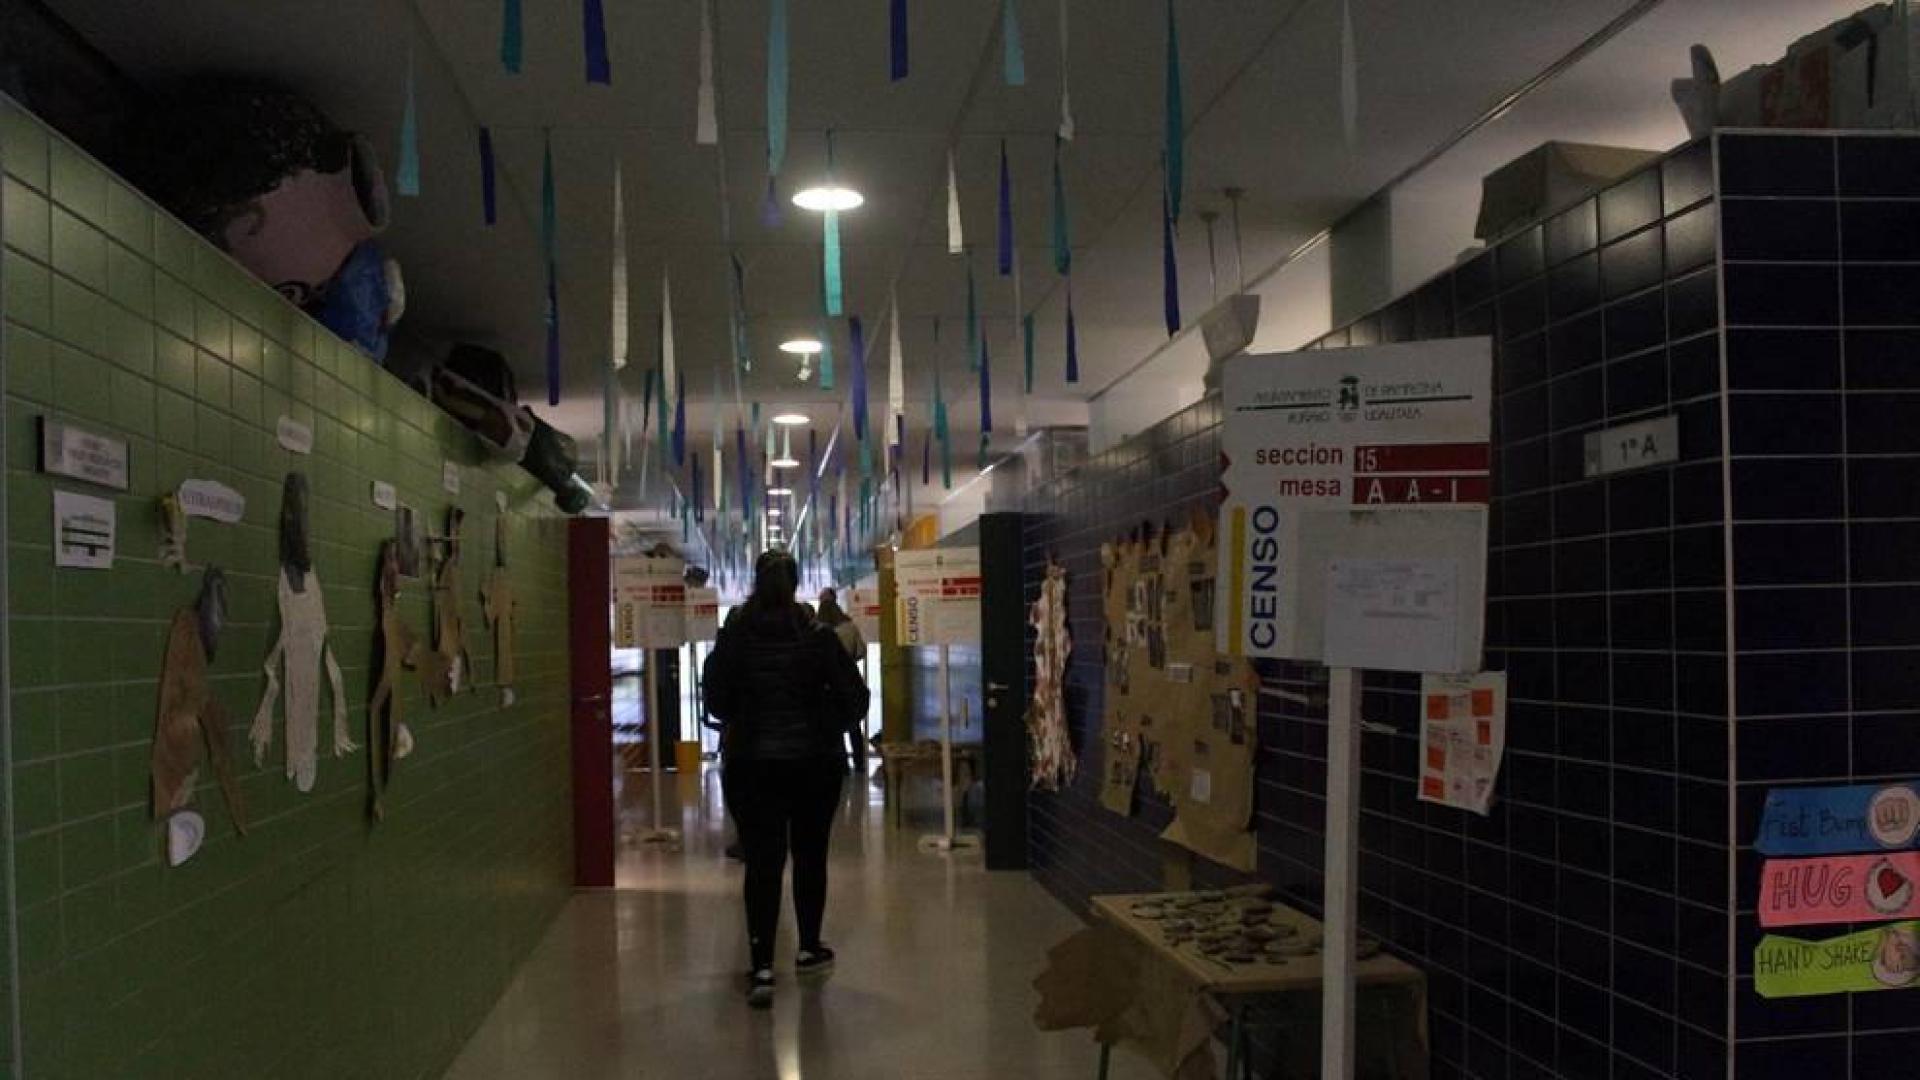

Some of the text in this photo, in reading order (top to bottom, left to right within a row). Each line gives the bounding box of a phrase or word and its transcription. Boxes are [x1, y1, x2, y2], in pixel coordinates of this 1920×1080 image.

[1255, 442, 1378, 472] seccion 15
[1279, 477, 1341, 497] mesa
[1367, 478, 1384, 504] A
[1249, 505, 1279, 649] CENSO
[1771, 864, 1854, 911] HUG
[1758, 939, 1873, 978] HAND SHAKE
